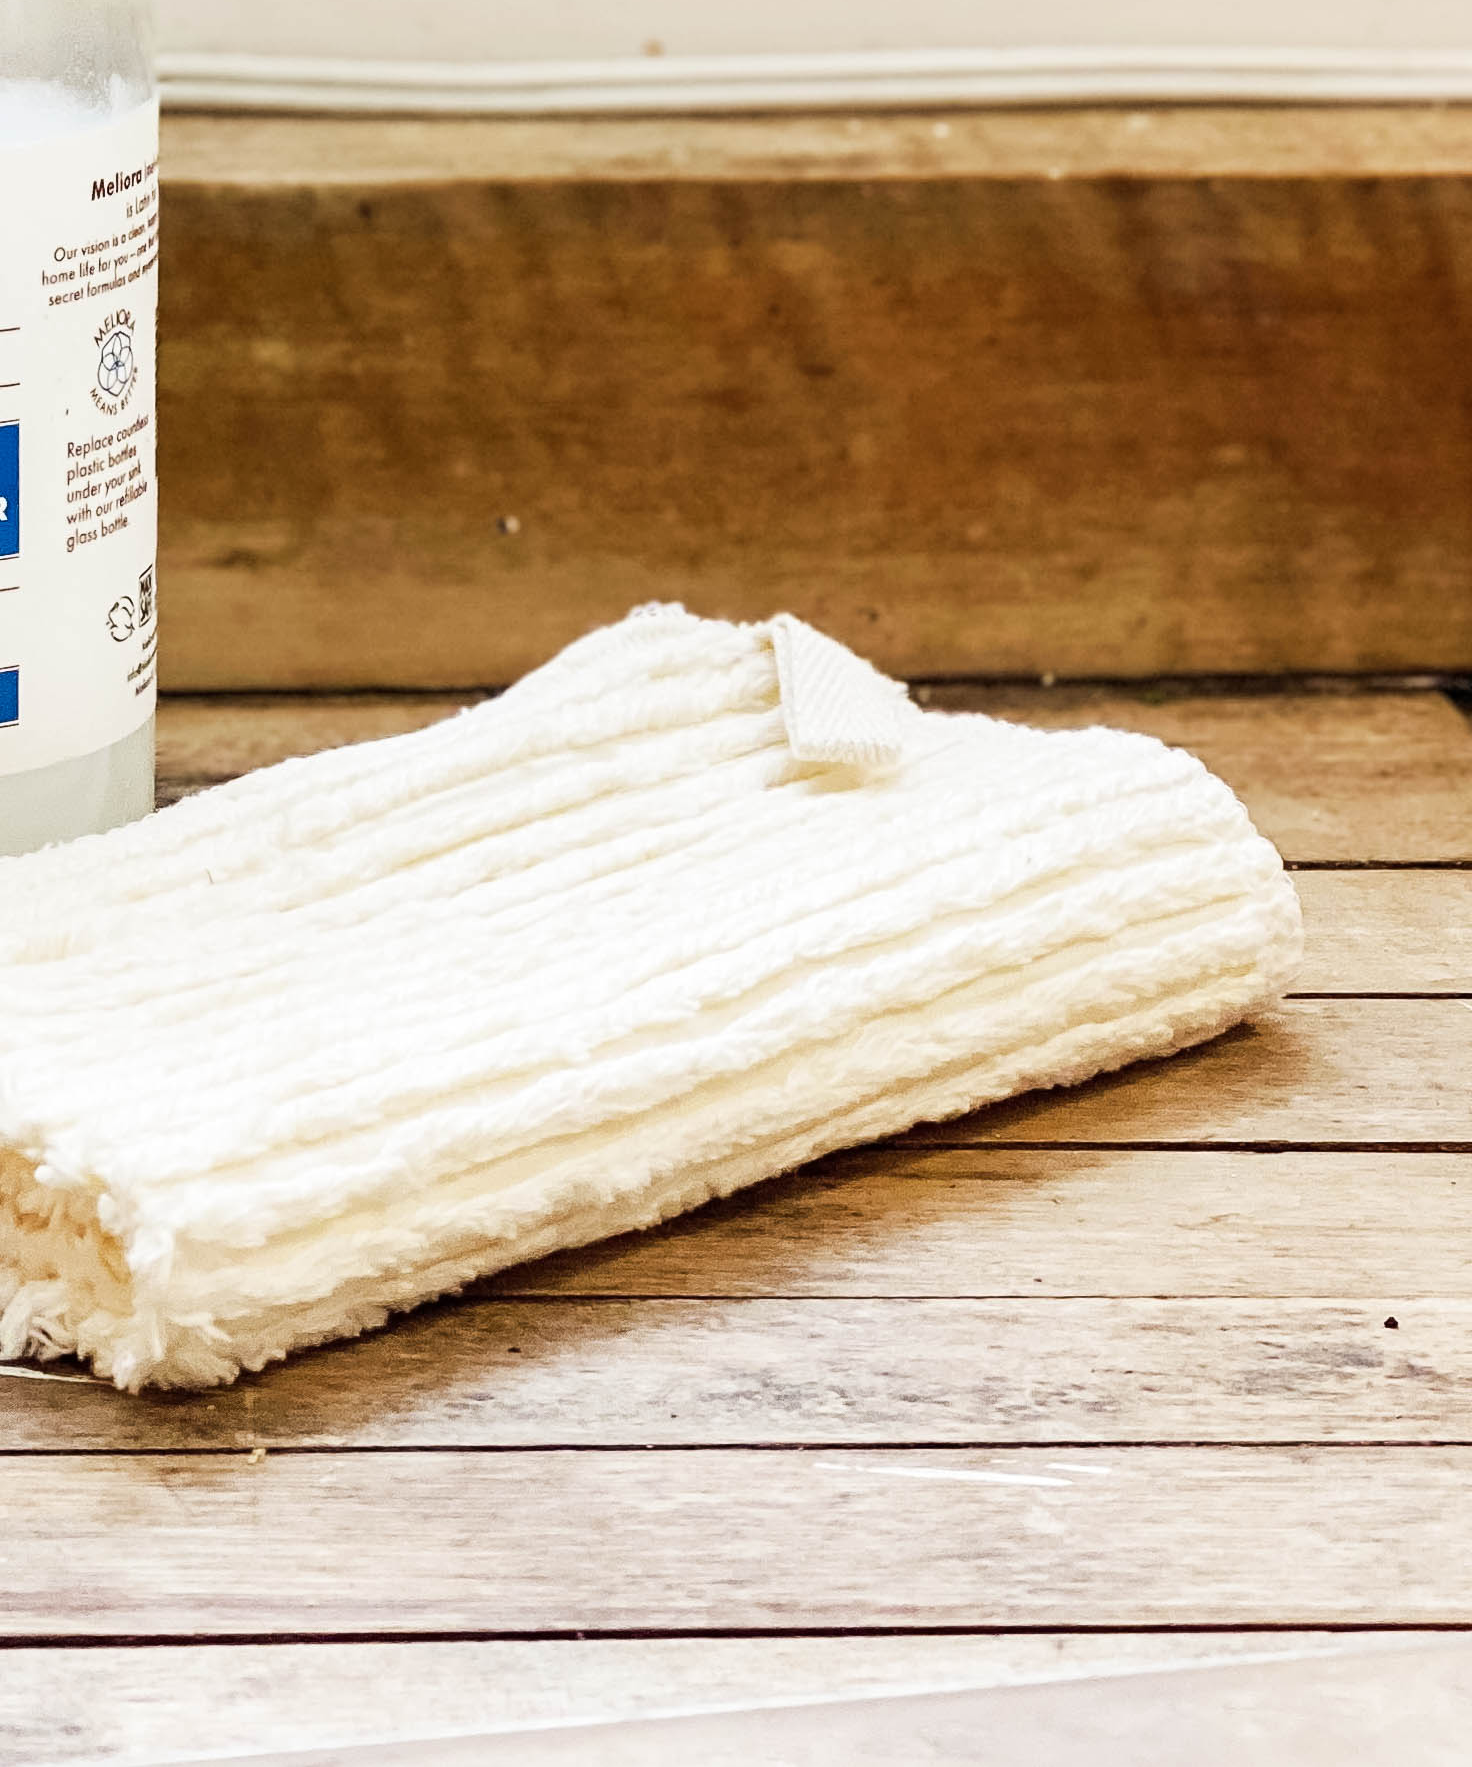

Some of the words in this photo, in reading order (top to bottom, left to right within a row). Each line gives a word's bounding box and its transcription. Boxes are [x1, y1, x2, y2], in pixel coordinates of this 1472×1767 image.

[91, 169, 142, 201] Meliora
[53, 246, 78, 262] Our
[81, 238, 110, 256] vision
[42, 269, 75, 286] home
[79, 261, 95, 278] life
[98, 257, 111, 272] for
[48, 287, 84, 307] secret
[87, 274, 126, 297] formulas
[67, 433, 114, 459] Replace
[67, 460, 105, 486] plastic
[67, 481, 102, 503] under
[104, 473, 126, 497] your
[67, 503, 92, 524] with
[95, 501, 113, 517] our
[66, 528, 97, 553] glass
